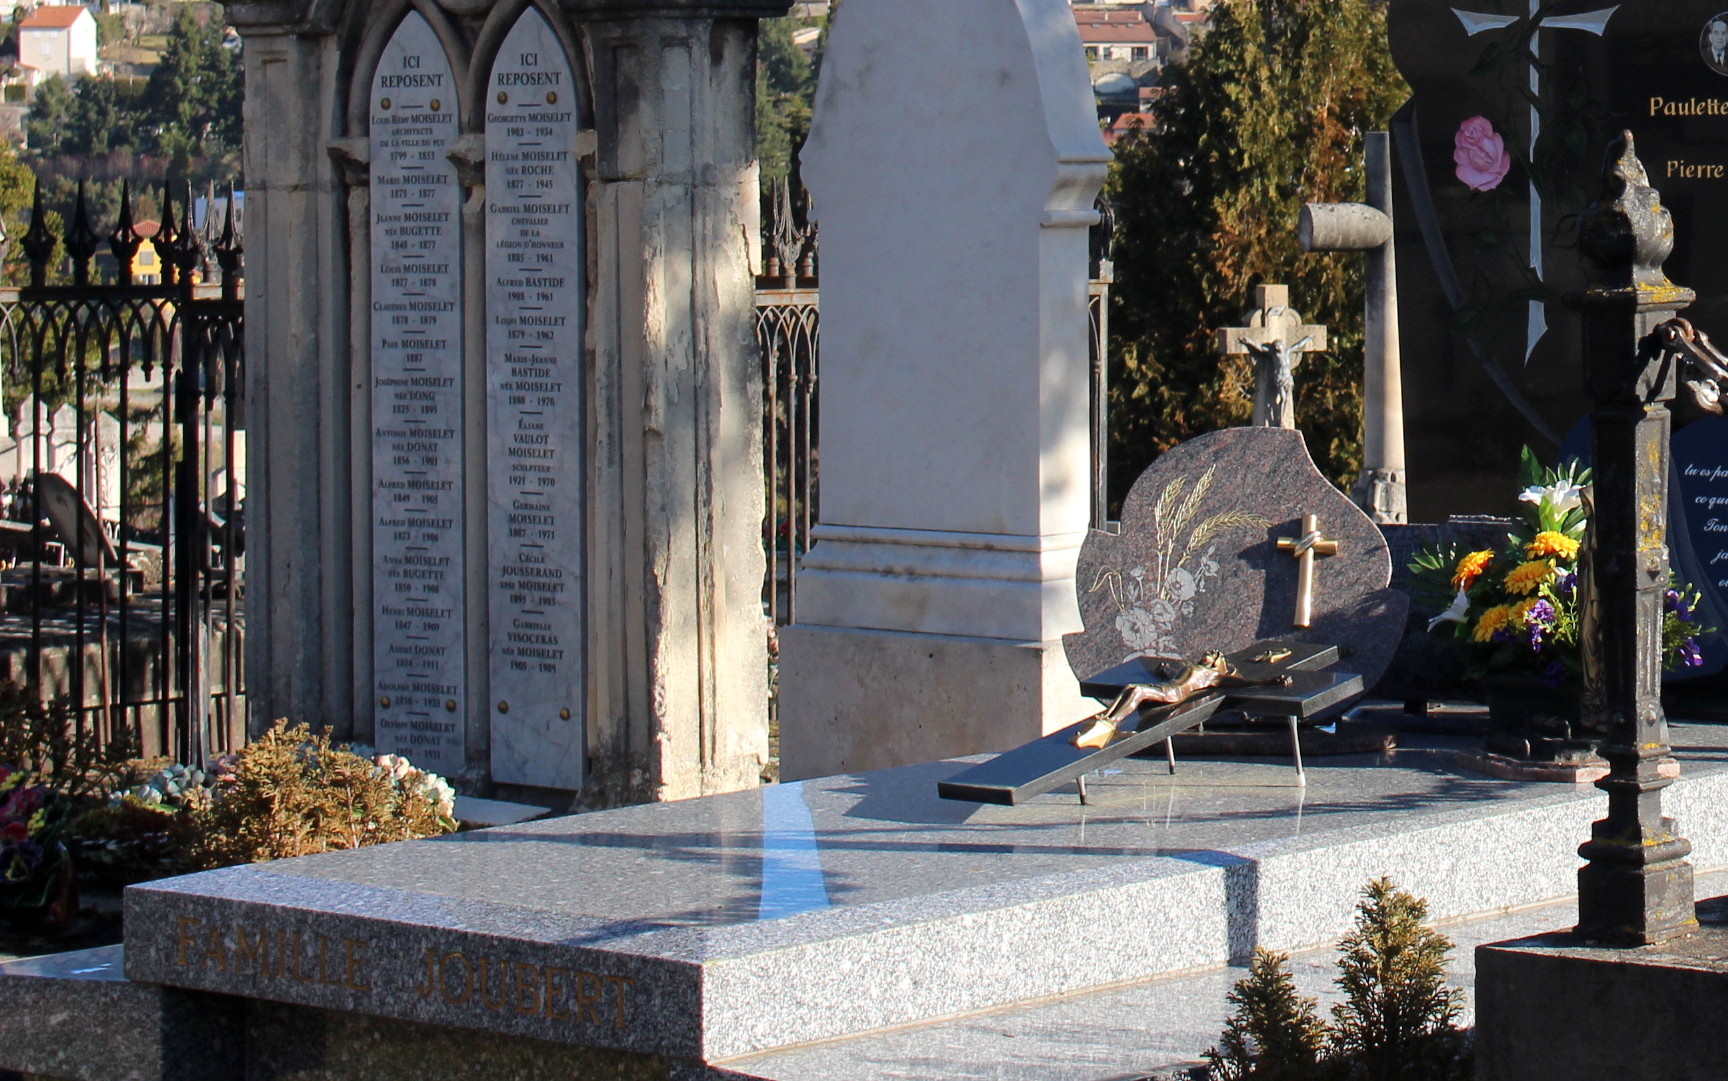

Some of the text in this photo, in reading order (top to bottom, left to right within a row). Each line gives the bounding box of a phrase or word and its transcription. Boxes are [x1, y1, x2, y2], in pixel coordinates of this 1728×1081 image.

[404, 56, 420, 68] ICI
[520, 54, 538, 65] ICI
[380, 74, 443, 87] REPOSENT
[497, 72, 561, 85] REPOSENT
[410, 114, 454, 123] MOISELET
[527, 112, 572, 123] MOISELET
[506, 127, 553, 136] 1903 1934
[390, 151, 435, 160] 1799 1855
[521, 151, 569, 162] MOISELET
[520, 164, 554, 175] ROCHE
[1666, 159, 1725, 179] Pierre
[401, 174, 449, 186] MOISELET
[506, 179, 553, 189] 1877 1945
[390, 188, 436, 198] 1875 1877
[522, 203, 571, 215] MOISELET
[403, 212, 450, 223] MOISELET
[399, 225, 443, 237] BUGETTE
[390, 240, 436, 250] 1848 1877
[507, 253, 553, 264] 1885 1961
[402, 263, 450, 275] MOISELET
[391, 277, 437, 288] 1877 1878
[525, 277, 565, 288] BASTIDE
[507, 291, 553, 302] 1908 1961
[408, 301, 456, 312] MOISELET
[391, 315, 437, 325] 1878 1879
[518, 315, 566, 327] MOISELET
[507, 330, 554, 340] 1879 1962
[400, 339, 447, 350] MOISELET
[406, 354, 423, 362] 1887
[511, 367, 551, 378] BASTIDE
[409, 376, 455, 387] MOISELET
[515, 381, 562, 392] MOISELET
[407, 390, 435, 401] LONG
[408, 428, 456, 439] MOISELET
[512, 434, 550, 445] VAULOT
[407, 442, 438, 453] DONAT
[508, 447, 555, 459] MOISELET
[407, 480, 454, 491] MOISELET
[1695, 496, 1707, 504] ce
[408, 517, 452, 529] MOISELET
[508, 513, 554, 526] MOISELET
[1704, 518, 1728, 532] Ton
[404, 555, 449, 567] MOISELET
[403, 569, 445, 580] BUGETTE
[501, 566, 562, 579] JOUSSERAND
[518, 581, 565, 592] MOISELET
[406, 607, 452, 618] MOISELET
[414, 645, 445, 656] DONAT
[517, 647, 564, 660] MOISELET
[412, 683, 457, 695] MOISELET
[410, 721, 456, 733] MOISELET
[410, 735, 440, 745] DONAT
[174, 917, 638, 1029] FAMILLE JOUBERT
